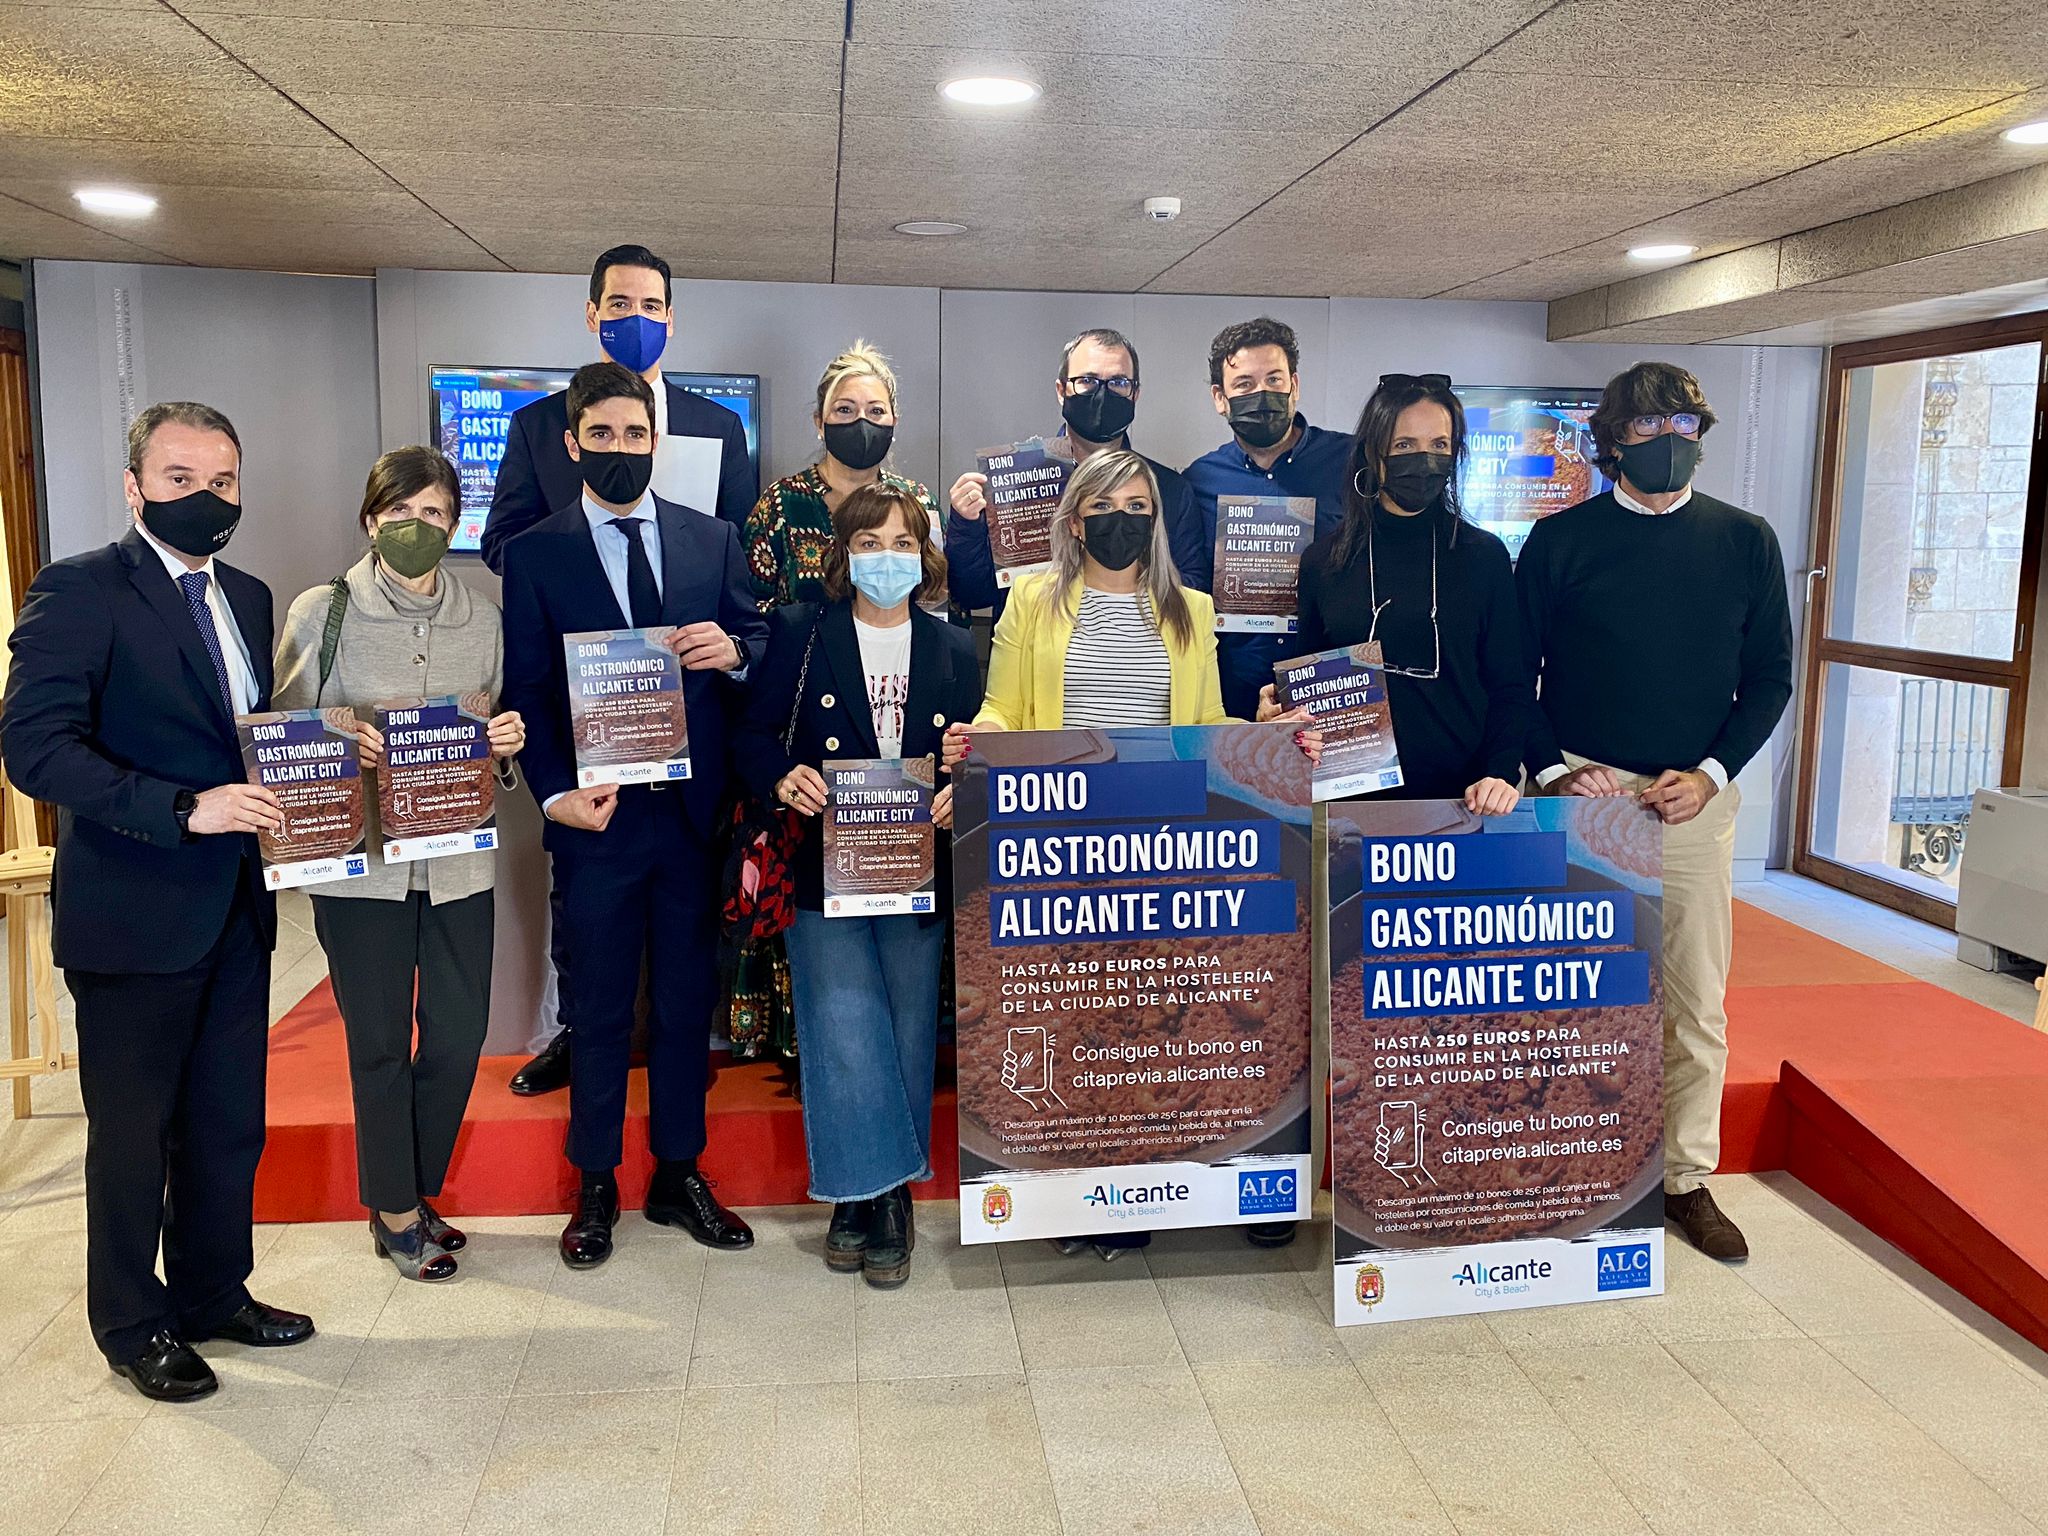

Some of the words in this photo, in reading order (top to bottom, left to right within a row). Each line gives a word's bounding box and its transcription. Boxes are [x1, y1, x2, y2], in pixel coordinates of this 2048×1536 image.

[462, 390, 502, 409] BONO
[463, 442, 505, 462] ALICA
[988, 455, 1013, 469] BONO
[991, 466, 1061, 487] GASTRONÓMICO
[1477, 458, 1508, 475] CITY
[993, 486, 1037, 504] ALICANTE
[1039, 483, 1060, 496] CITY
[1228, 506, 1253, 517] BONO
[1227, 522, 1300, 536] GASTRONÓMICO
[1226, 539, 1271, 551] ALICANTE
[1274, 541, 1295, 552] CITY
[578, 643, 607, 657] BONO
[580, 658, 664, 676] GASTRONÓMICO
[1288, 666, 1315, 682] BONO
[581, 679, 634, 695] ALICANTE
[637, 677, 661, 690] CITY
[1291, 672, 1368, 700] GASTRONÓMICO
[1306, 696, 1342, 714] ICANTE
[1344, 690, 1367, 706] CITY
[388, 710, 418, 725] BONO
[252, 725, 285, 740] BONO
[389, 725, 474, 745] GASTRONÓMICO
[257, 740, 344, 762] GASTRONÓMICO
[390, 747, 444, 764] ALICANTE
[447, 744, 471, 759] CITY
[263, 765, 316, 783] ALICANTE
[318, 762, 342, 778] CITY
[617, 767, 651, 776] Alicante
[836, 772, 864, 784] BONO
[1379, 773, 1397, 782] ALC
[997, 771, 1087, 812] BONO
[1331, 778, 1364, 790] Alicante
[417, 794, 445, 803] Consigue
[836, 788, 918, 804] GASTRONÓMICO
[836, 809, 887, 822] ALICANTE
[891, 808, 914, 821] CITY
[423, 838, 457, 849] Alicante
[474, 835, 491, 843] ALC
[997, 824, 1257, 878] GASTRONÓMICO
[1371, 840, 1455, 881] BONO
[298, 864, 331, 876] Alicante
[346, 860, 363, 869] ALC
[998, 892, 1159, 937] ALICANTE
[1172, 888, 1245, 929] CITY
[1371, 895, 1614, 948] GASTRONÓMICO
[1001, 962, 1060, 977] HASTA
[1067, 960, 1099, 974] 250
[1106, 957, 1166, 972] EUROS
[1173, 955, 1220, 969] PARA
[1001, 979, 1097, 995] CONSUMIR
[1106, 977, 1128, 989] EN
[1136, 976, 1156, 988] LA
[1163, 967, 1273, 987] HOSTELERÍA
[1371, 964, 1523, 1009] ALICANTE
[1535, 960, 1603, 1002] CITY
[1002, 1000, 1025, 1013] DE
[1033, 999, 1053, 1011] LA
[1060, 995, 1129, 1010] CIUDAD
[1137, 993, 1159, 1006] DE
[1374, 1035, 1430, 1050] HASTA
[1437, 1033, 1467, 1047] 250
[1473, 1030, 1530, 1045] EUROS
[1536, 1027, 1580, 1041] PARA
[1072, 1041, 1159, 1062] Consigue
[1165, 1039, 1182, 1056] tu
[1187, 1037, 1234, 1055] bono
[1240, 1038, 1262, 1052] en
[1374, 1052, 1466, 1069] CONSUMIR
[1473, 1050, 1494, 1063] EN
[1502, 1049, 1520, 1061] LA
[1527, 1040, 1629, 1060] HOSTELERÍA
[1072, 1060, 1265, 1089] citaprevia.alicante.es
[1375, 1074, 1397, 1087] DE
[1404, 1072, 1424, 1085] LA
[1431, 1068, 1495, 1084] CIUDAD
[1502, 1066, 1523, 1079] DE
[1095, 1115, 1106, 1123] de
[1108, 1114, 1117, 1122] 10
[1119, 1112, 1145, 1121] bonos
[1147, 1111, 1158, 1119] de
[1160, 1110, 1177, 1119] 25€
[1179, 1111, 1198, 1119] para
[1199, 1108, 1230, 1117] canjear
[1244, 1105, 1252, 1113] la
[1441, 1115, 1523, 1137] Consigue
[1529, 1113, 1545, 1131] tu
[1550, 1110, 1593, 1129] bono
[1598, 1112, 1619, 1126] en
[1045, 1132, 1059, 1140] por
[1061, 1127, 1124, 1137] consumiciones
[1125, 1125, 1137, 1133] de
[1139, 1123, 1170, 1132] comida
[1172, 1124, 1177, 1132] y
[1179, 1121, 1207, 1130] bebida
[1224, 1119, 1232, 1127] al
[1442, 1134, 1622, 1165] citaprevia.alicante.es
[1083, 1180, 1189, 1206] Alicante
[1240, 1175, 1293, 1197] ALC
[1107, 1208, 1125, 1218] City
[1137, 1205, 1165, 1214] Beach
[1452, 1257, 1551, 1285] Alicante
[1600, 1250, 1648, 1273] ALC
[1475, 1287, 1492, 1297] City
[1494, 1286, 1501, 1294] &
[1504, 1283, 1530, 1293] Beach
